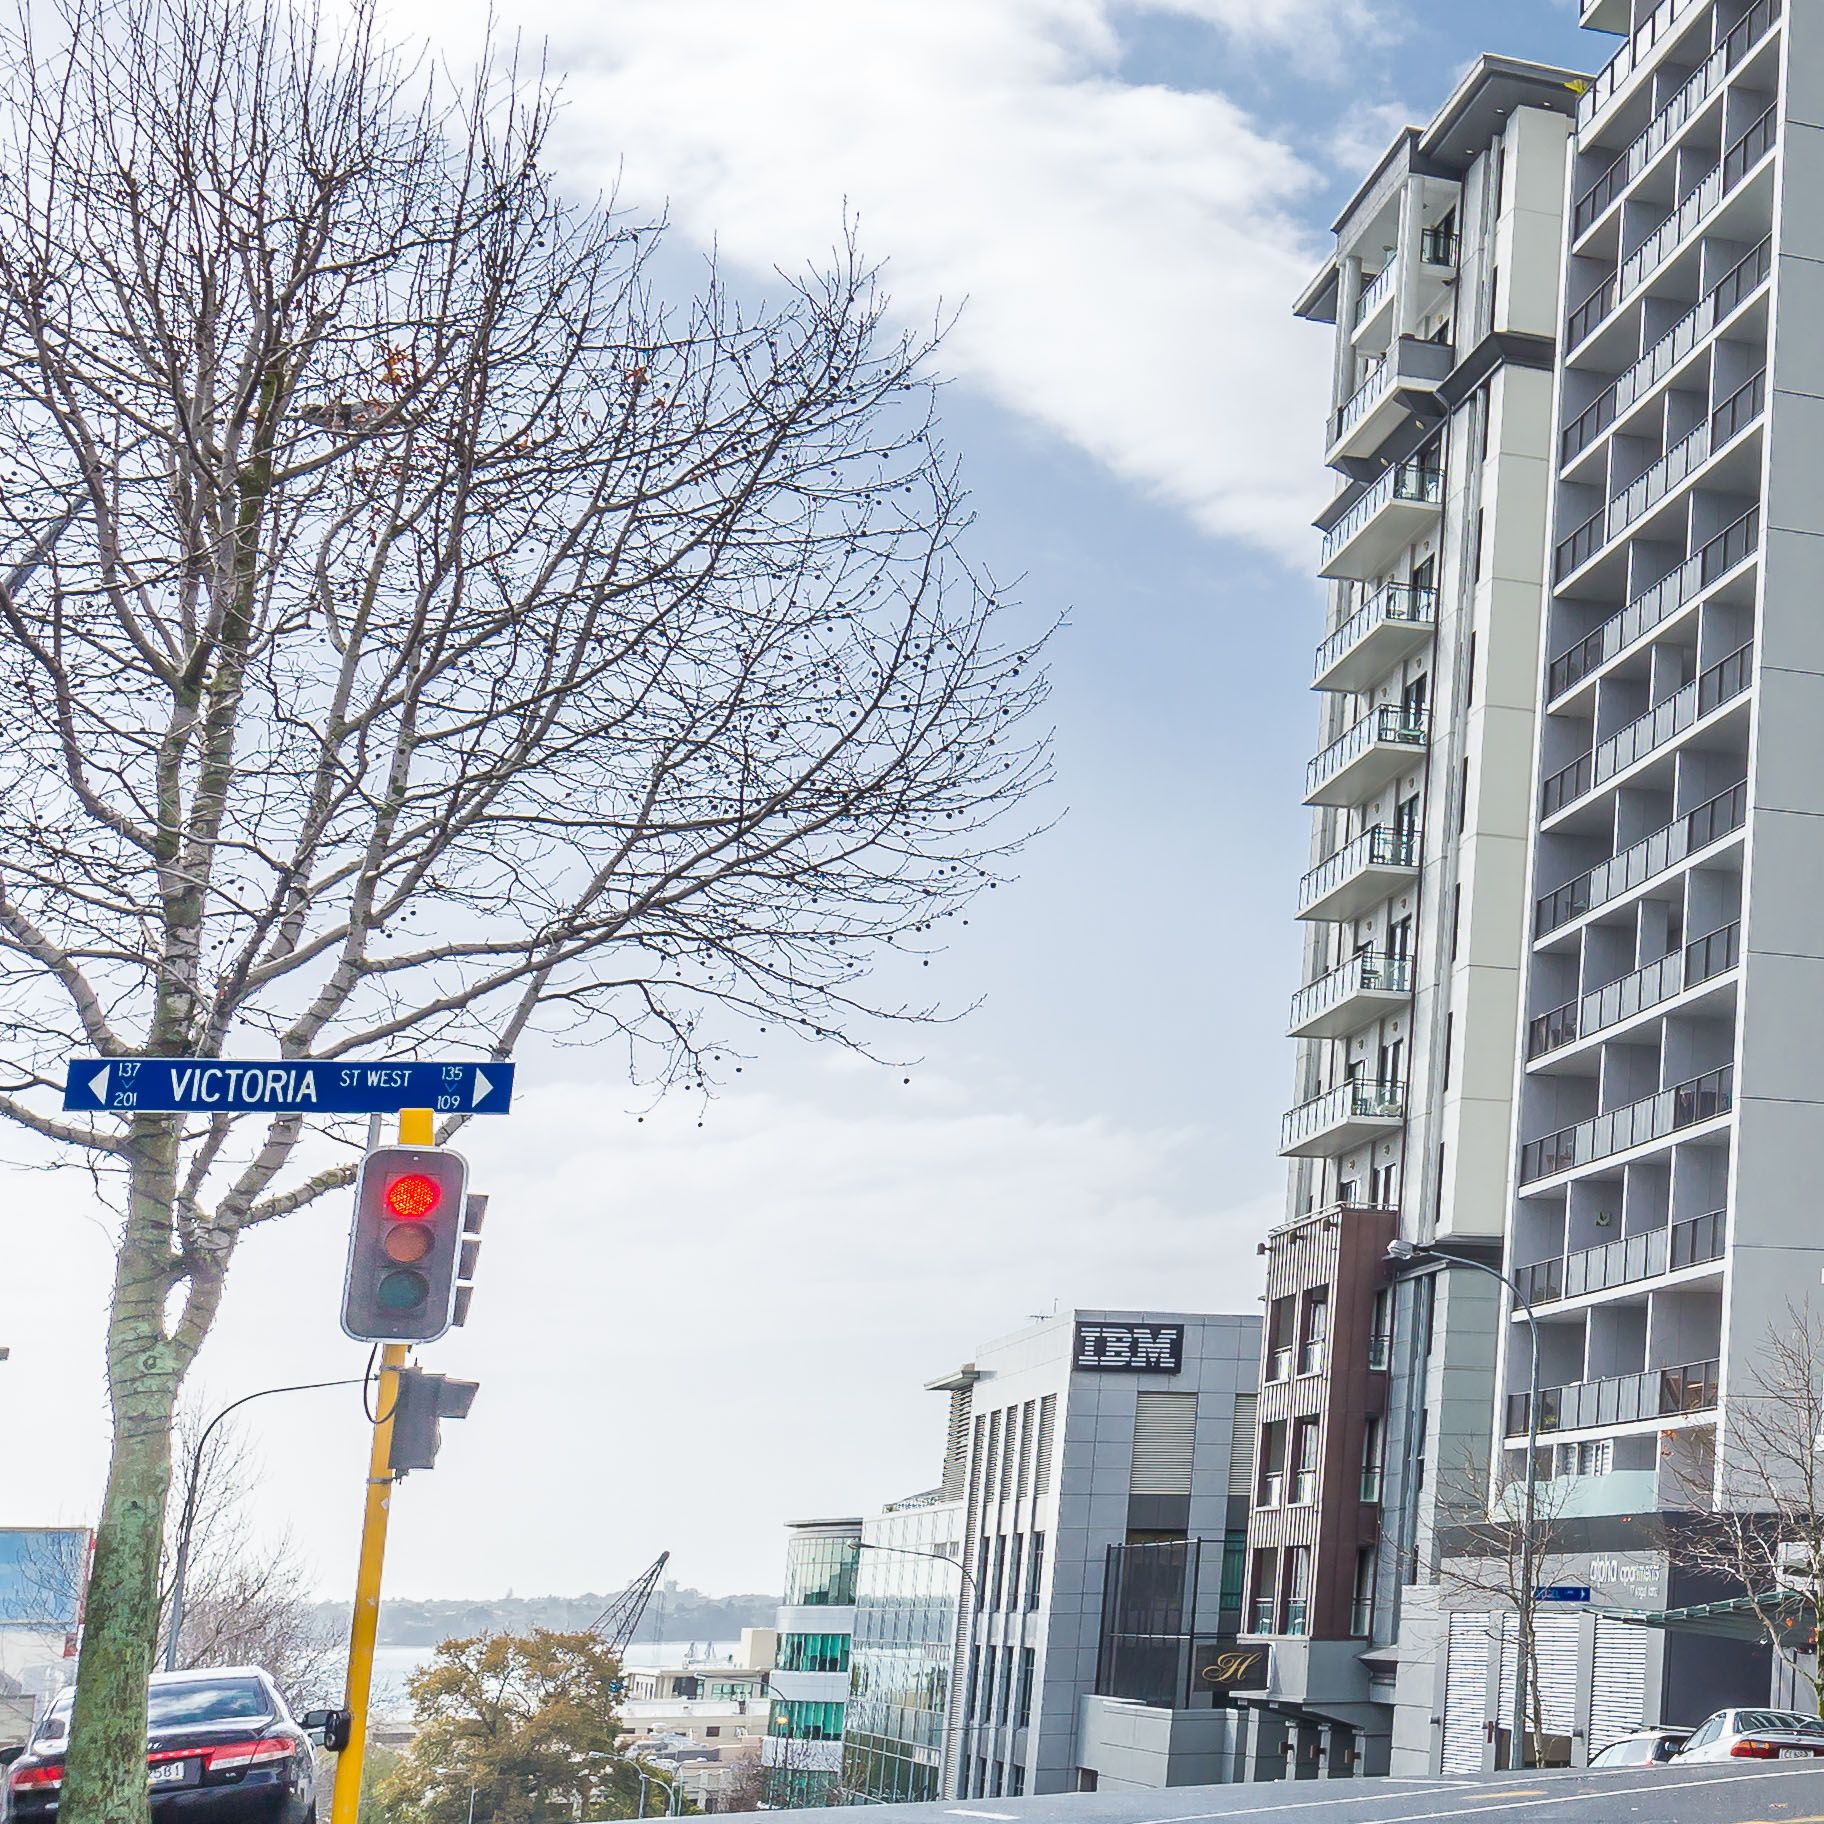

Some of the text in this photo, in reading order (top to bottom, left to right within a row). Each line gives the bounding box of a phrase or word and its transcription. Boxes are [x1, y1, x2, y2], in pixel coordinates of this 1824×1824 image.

[118, 1062, 142, 1077] 137
[441, 1066, 463, 1081] 135
[170, 1068, 413, 1103] VICTORIA ST WEST
[113, 1091, 138, 1107] 201
[437, 1095, 461, 1110] 109
[1078, 1327, 1177, 1367] IBM
